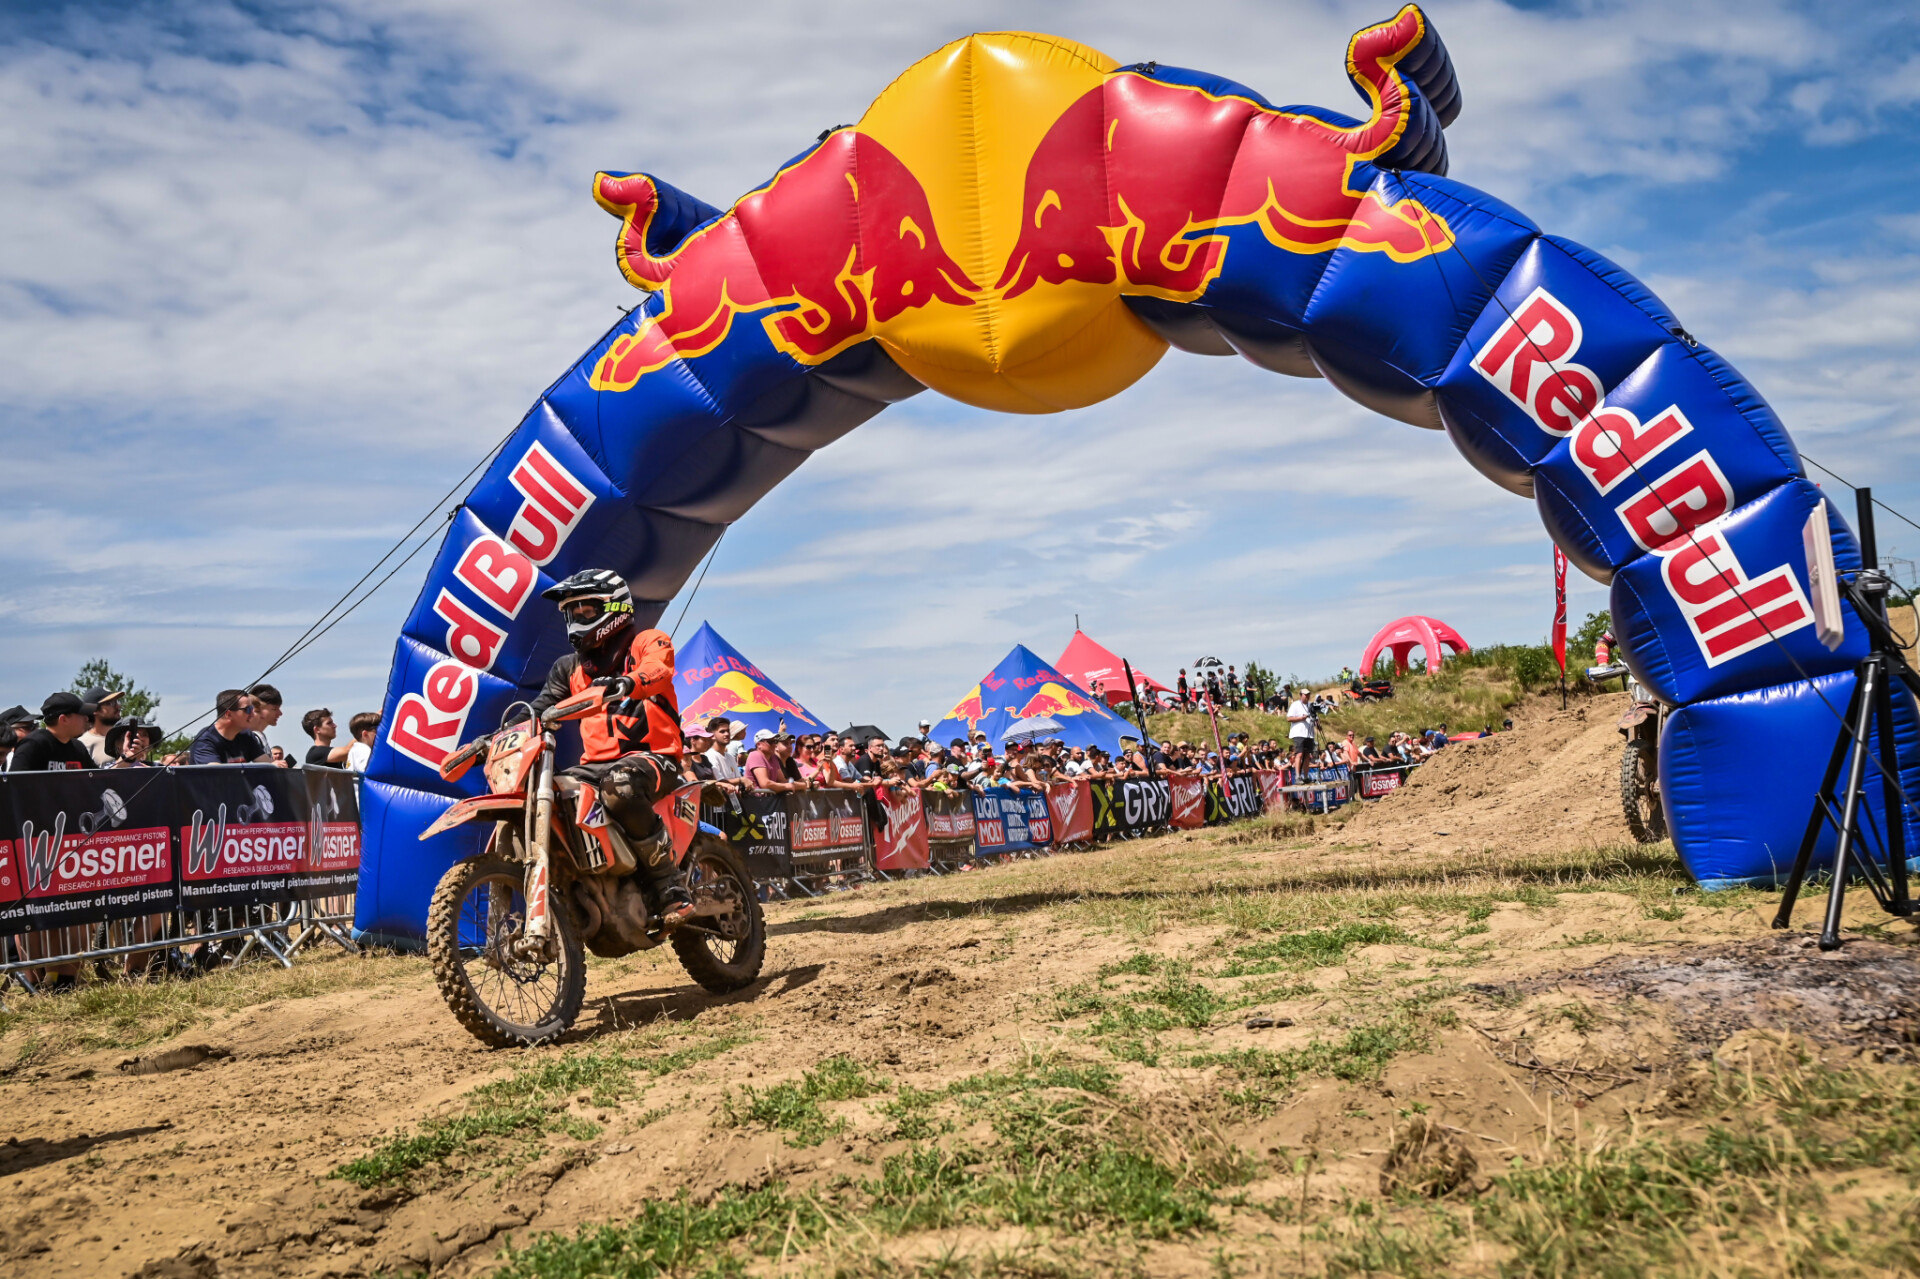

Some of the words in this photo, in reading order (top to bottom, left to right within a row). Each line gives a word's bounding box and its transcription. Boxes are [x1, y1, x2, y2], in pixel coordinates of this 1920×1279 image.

[1471, 287, 1692, 495] Red
[1616, 450, 1814, 667] Bull
[388, 588, 507, 770] Red
[454, 441, 595, 619] Bull
[603, 602, 634, 613] 100%
[682, 656, 729, 686] Red
[727, 656, 766, 680] Bull
[1012, 670, 1045, 690] Red
[493, 733, 520, 756] 772
[682, 801, 696, 823] 772
[975, 798, 1000, 818] LIQUI
[731, 811, 787, 840] X-GRIP
[979, 821, 1003, 844] MOLY
[95, 833, 142, 845] PERFORMANCE
[143, 831, 167, 841] PISTONS
[749, 845, 767, 855] STAY
[223, 866, 251, 874] RESEARCH
[256, 863, 291, 872] DEVELOPMENT
[58, 880, 96, 891] RESEARCH
[96, 879, 102, 887] &
[102, 874, 148, 887] DEVELOPMENT
[182, 880, 249, 896] Manufacturer
[251, 879, 260, 890] of
[261, 877, 285, 892] forged
[26, 899, 92, 915] Manufacturer
[95, 895, 105, 906] of
[108, 891, 140, 905] forged
[142, 887, 173, 901] pistons
